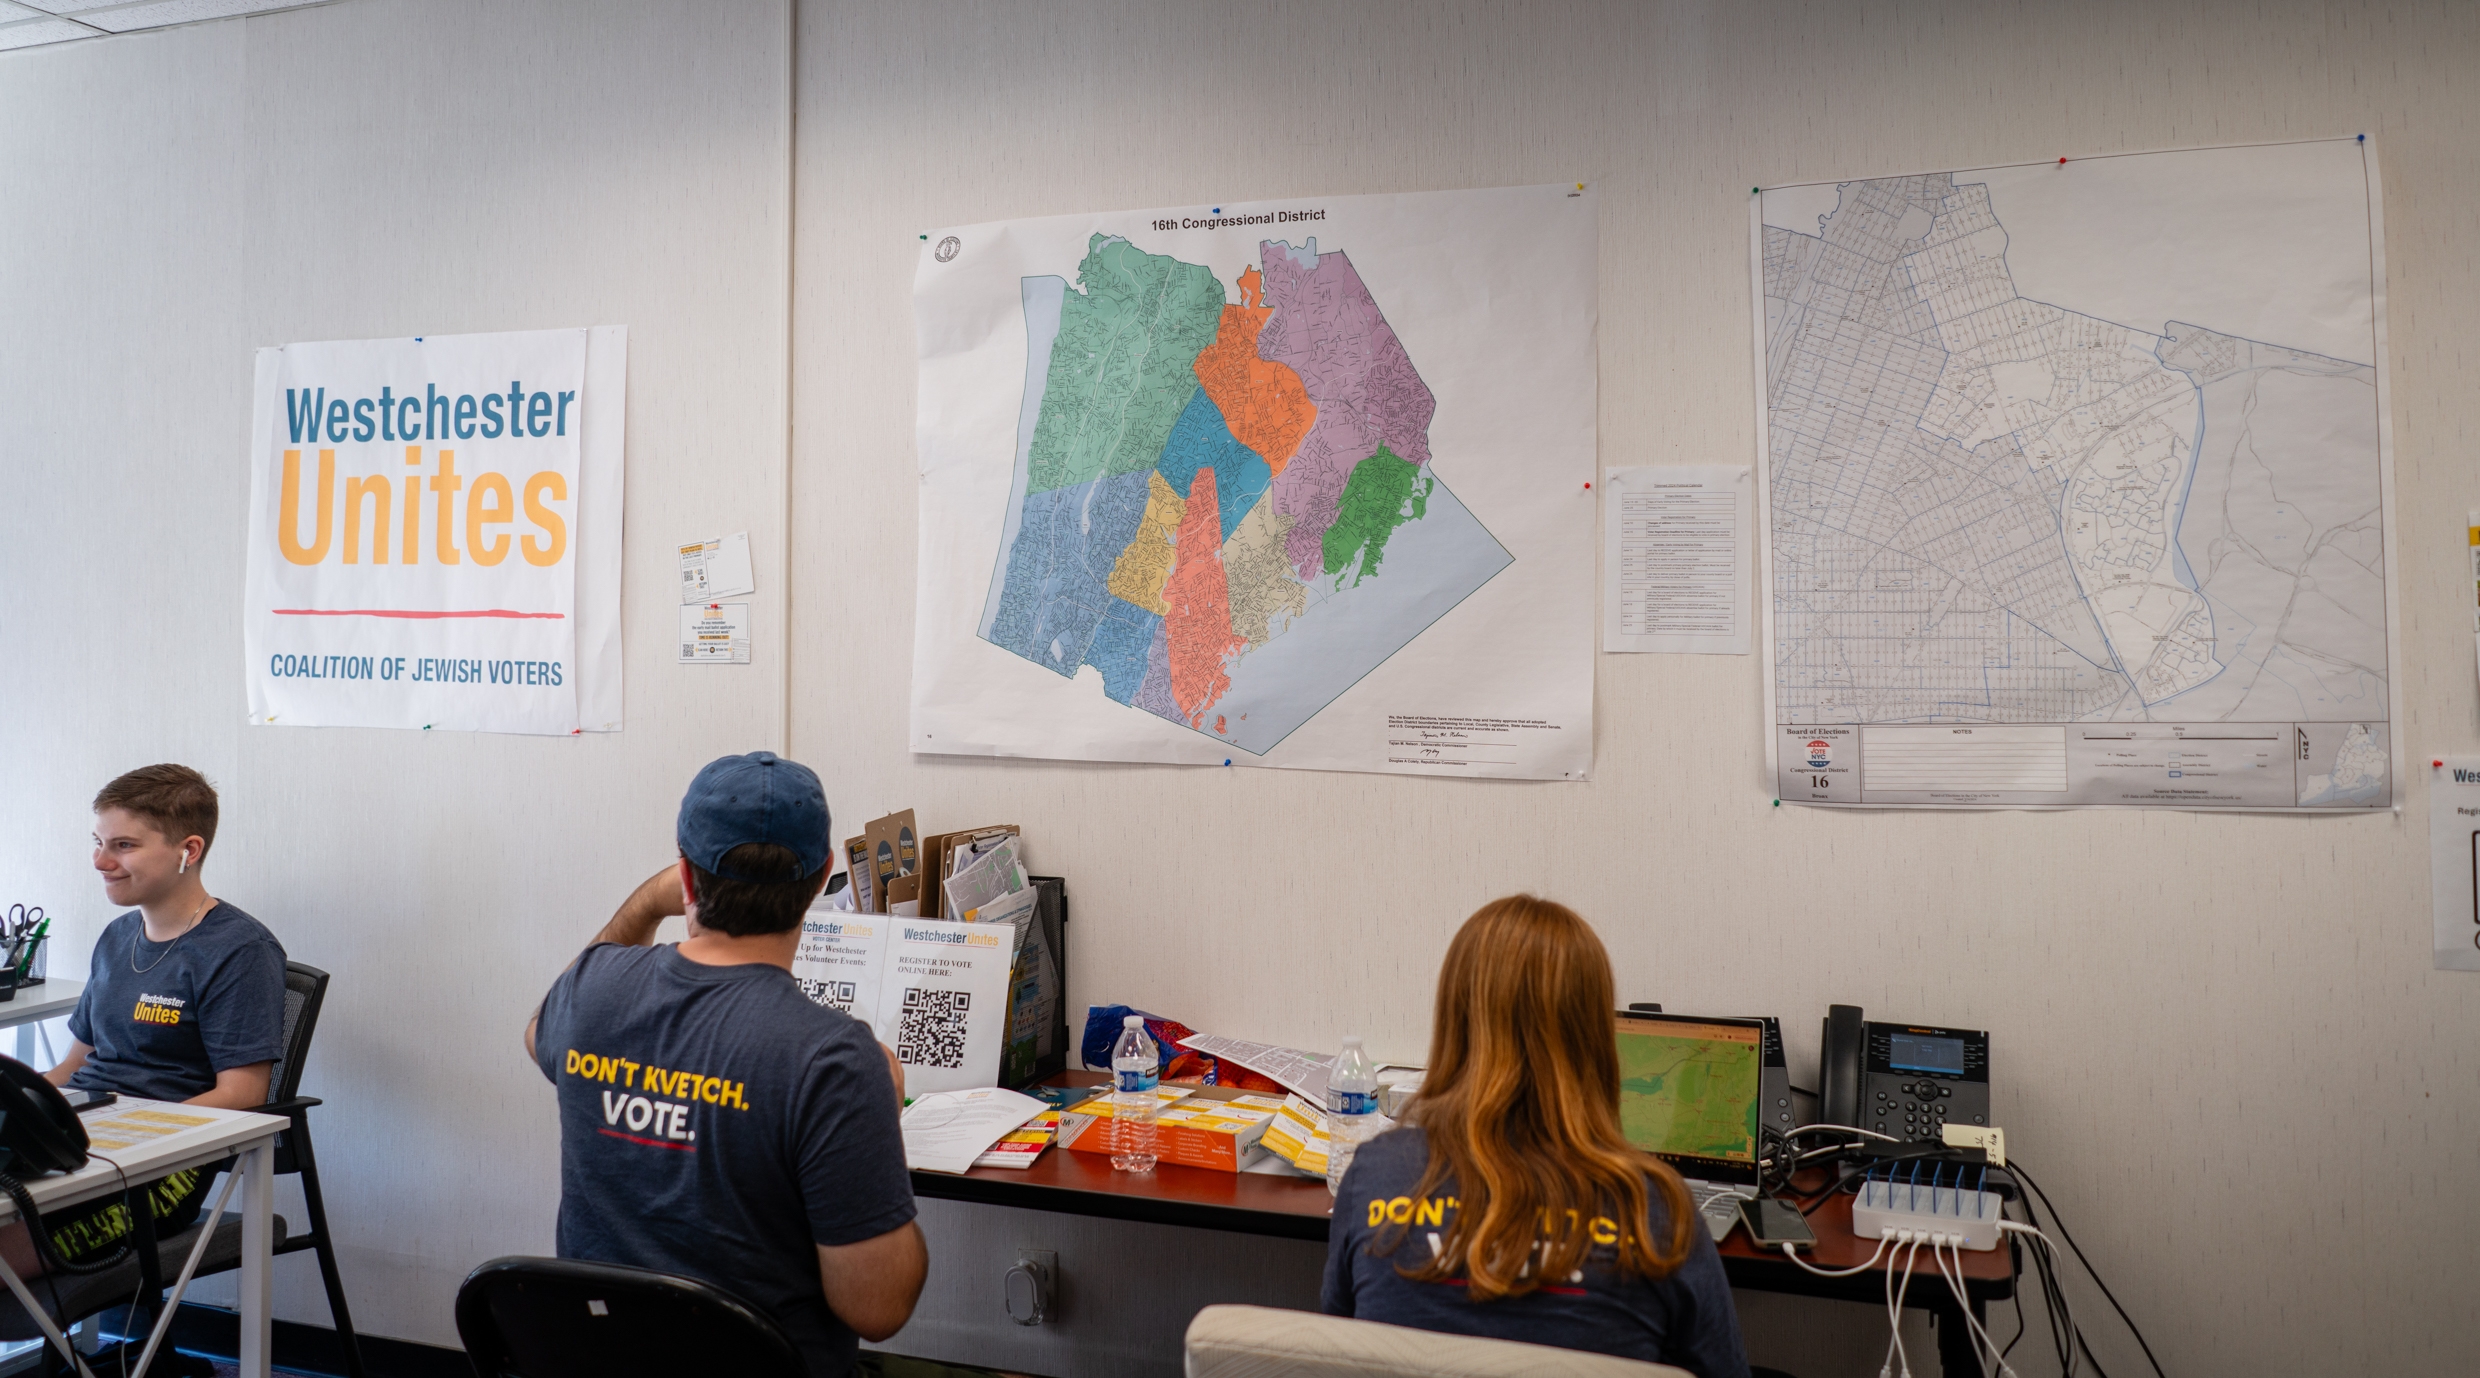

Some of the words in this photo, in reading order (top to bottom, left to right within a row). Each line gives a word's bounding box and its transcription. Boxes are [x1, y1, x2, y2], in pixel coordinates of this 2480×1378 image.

[1151, 219, 1178, 231] 16th
[1182, 212, 1275, 230] Congressional
[1278, 208, 1326, 223] District
[286, 381, 576, 443] Westchester
[277, 445, 568, 567] Unites
[270, 653, 374, 680] COALITION
[380, 656, 406, 681] OF
[411, 657, 483, 683] JEWISH
[487, 660, 563, 687] VOTERS
[1811, 775, 1829, 788] 16
[2458, 807, 2480, 816] Regi
[843, 923, 873, 936] Unites
[904, 928, 967, 944] Westchester
[967, 932, 999, 946] Unites
[800, 943, 811, 952] Up
[825, 945, 867, 955] Westchester
[805, 954, 838, 964] Volunteer
[840, 957, 866, 966] Events:
[899, 956, 937, 966] REGISTER
[951, 960, 973, 968] VOTE
[898, 966, 927, 975] ONLINE
[929, 968, 952, 977] HERE:
[140, 993, 186, 1008] Westchester
[134, 1002, 181, 1024] Unites
[566, 1048, 641, 1088] DON'T
[643, 1065, 750, 1111] KVETCH.
[602, 1090, 696, 1142] VOTE.
[1368, 1196, 1461, 1227] DON'
